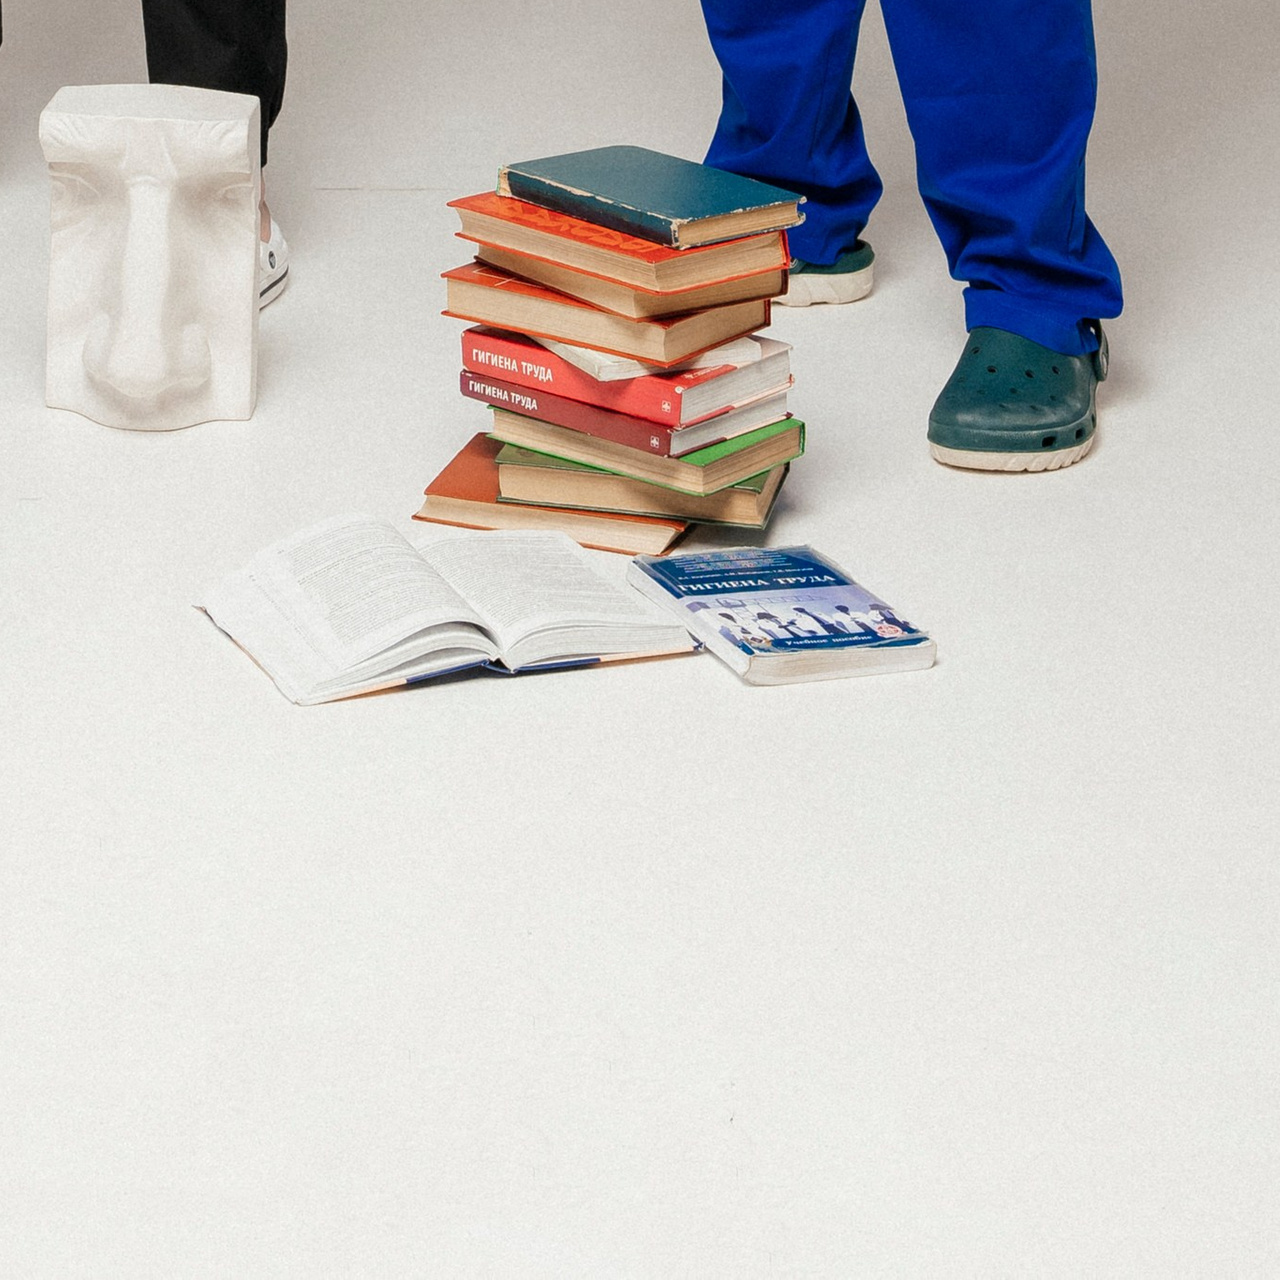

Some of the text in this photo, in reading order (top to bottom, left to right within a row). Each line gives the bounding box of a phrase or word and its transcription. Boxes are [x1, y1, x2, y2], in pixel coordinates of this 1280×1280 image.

[472, 348, 553, 383] ГИГИЕНА ТРУДА
[469, 380, 538, 411] ГИГИЕНА ТРУДА
[678, 578, 770, 591] ГИГИЕНА
[772, 574, 837, 585] ТРУДА
[785, 635, 873, 646] Учебное пособие
